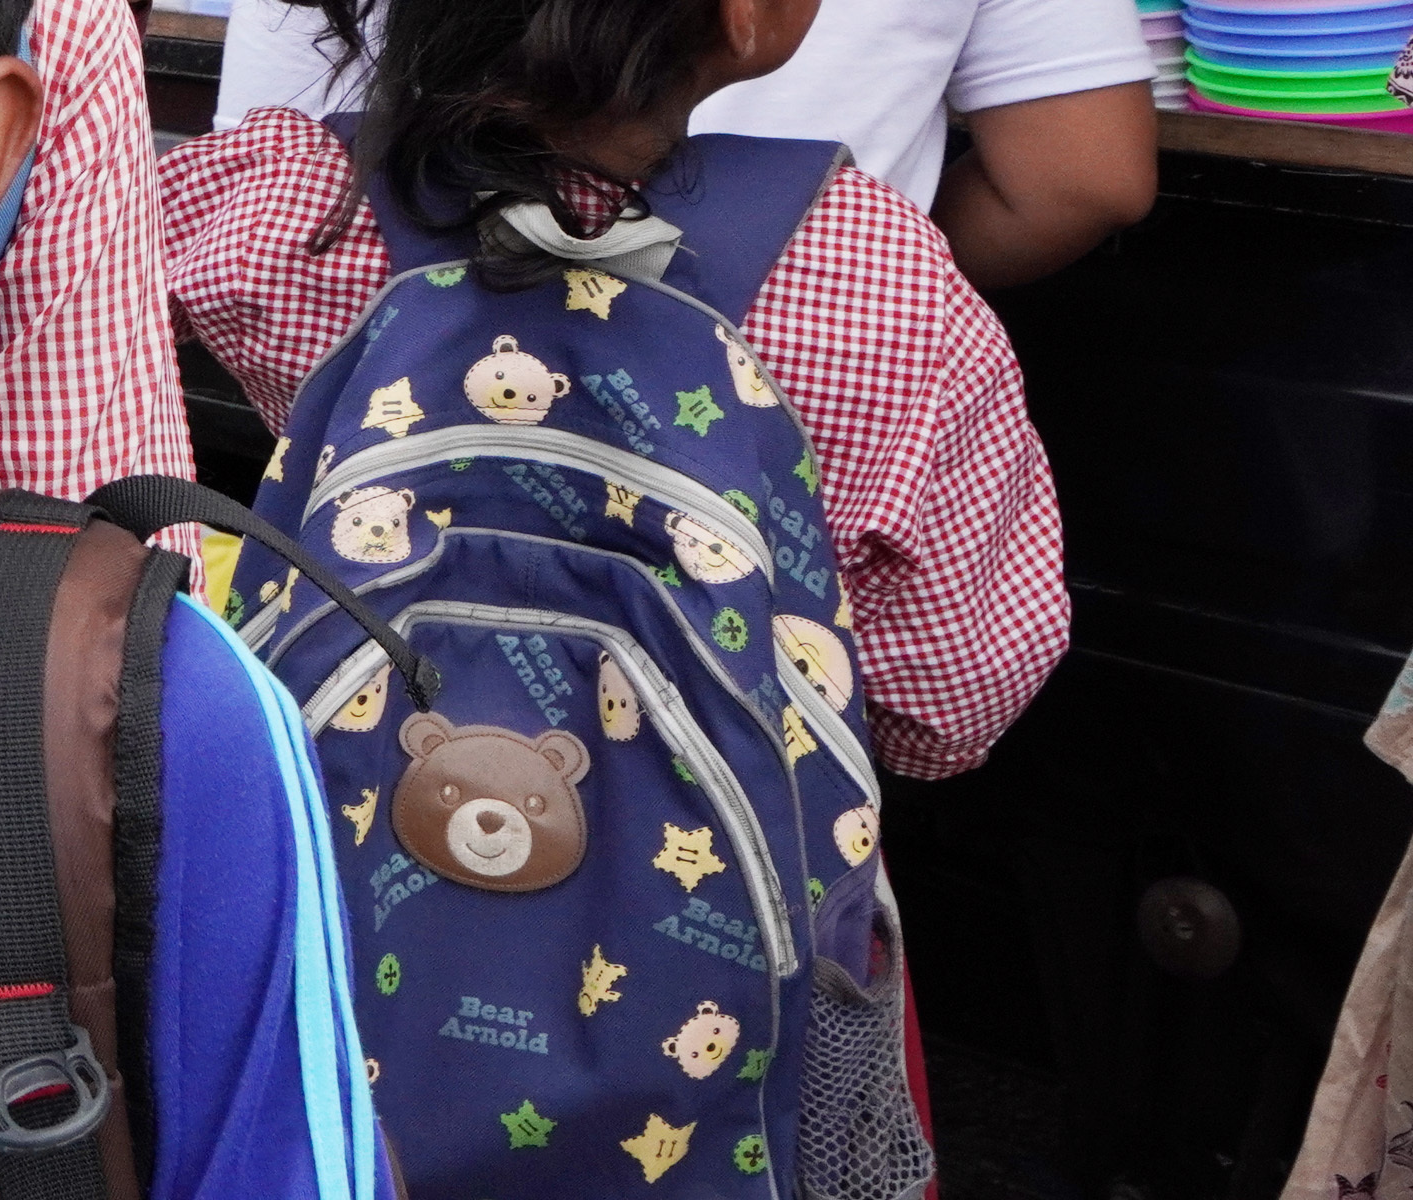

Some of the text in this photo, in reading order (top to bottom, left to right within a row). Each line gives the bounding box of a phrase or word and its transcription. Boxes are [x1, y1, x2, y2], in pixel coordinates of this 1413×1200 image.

[606, 368, 662, 431] Bear
[502, 464, 587, 541] Arnold
[495, 634, 570, 727] Arnold
[524, 634, 573, 696] Bear
[682, 897, 759, 943] Bear
[438, 1017, 549, 1055] Arnold
[458, 996, 534, 1028] Bear
